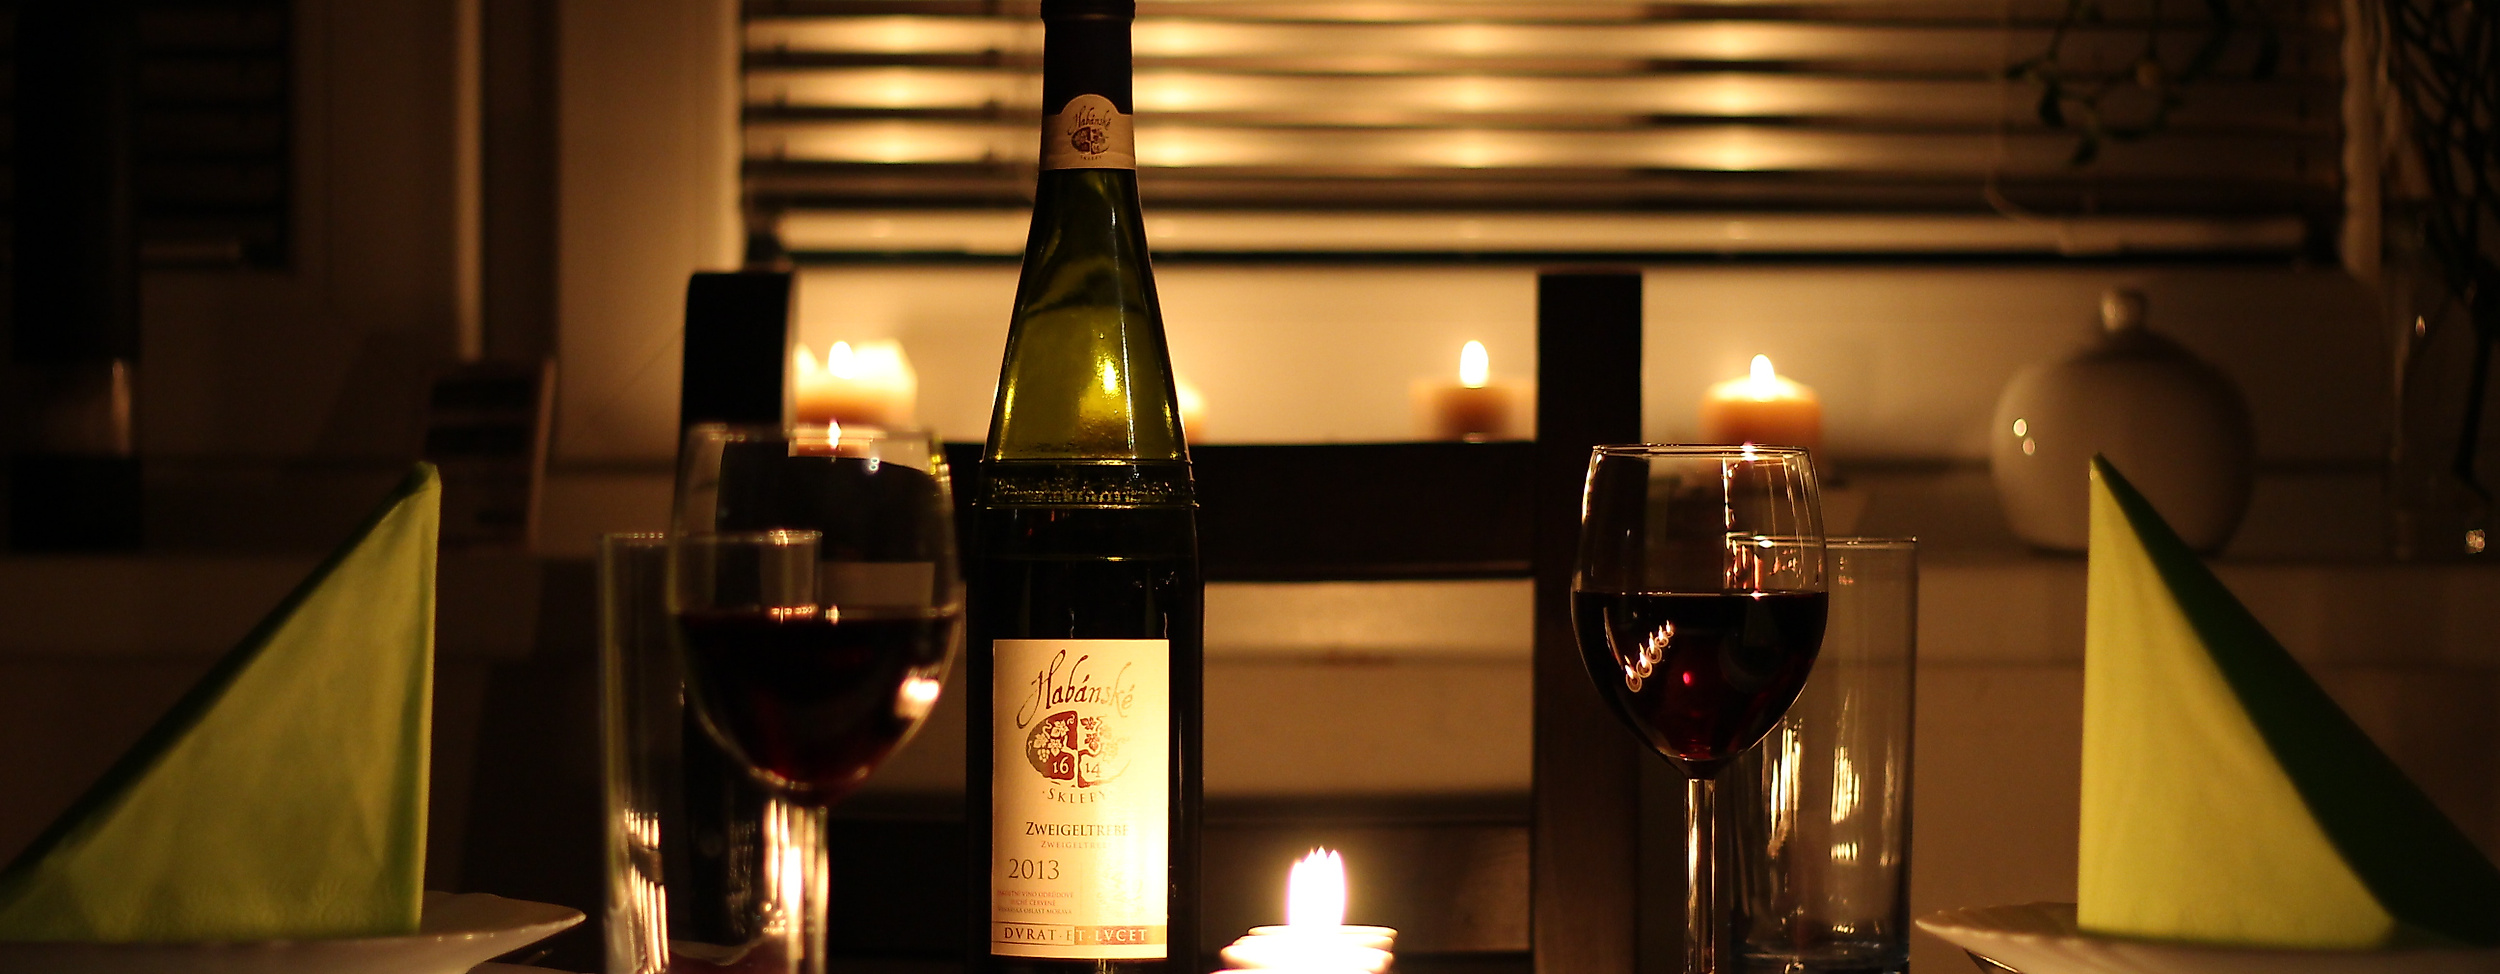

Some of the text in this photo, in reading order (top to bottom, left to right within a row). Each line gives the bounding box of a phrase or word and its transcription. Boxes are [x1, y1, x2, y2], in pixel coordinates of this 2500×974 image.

[1016, 648, 1137, 730] Habánské
[1052, 756, 1102, 778] 16 14
[1025, 821, 1129, 837] ZWEIGELTREBE
[1041, 841, 1112, 849] ZWEIGELTRE
[1008, 858, 1060, 880] 2013
[1004, 927, 1148, 942] DVRAT ET LVCET
